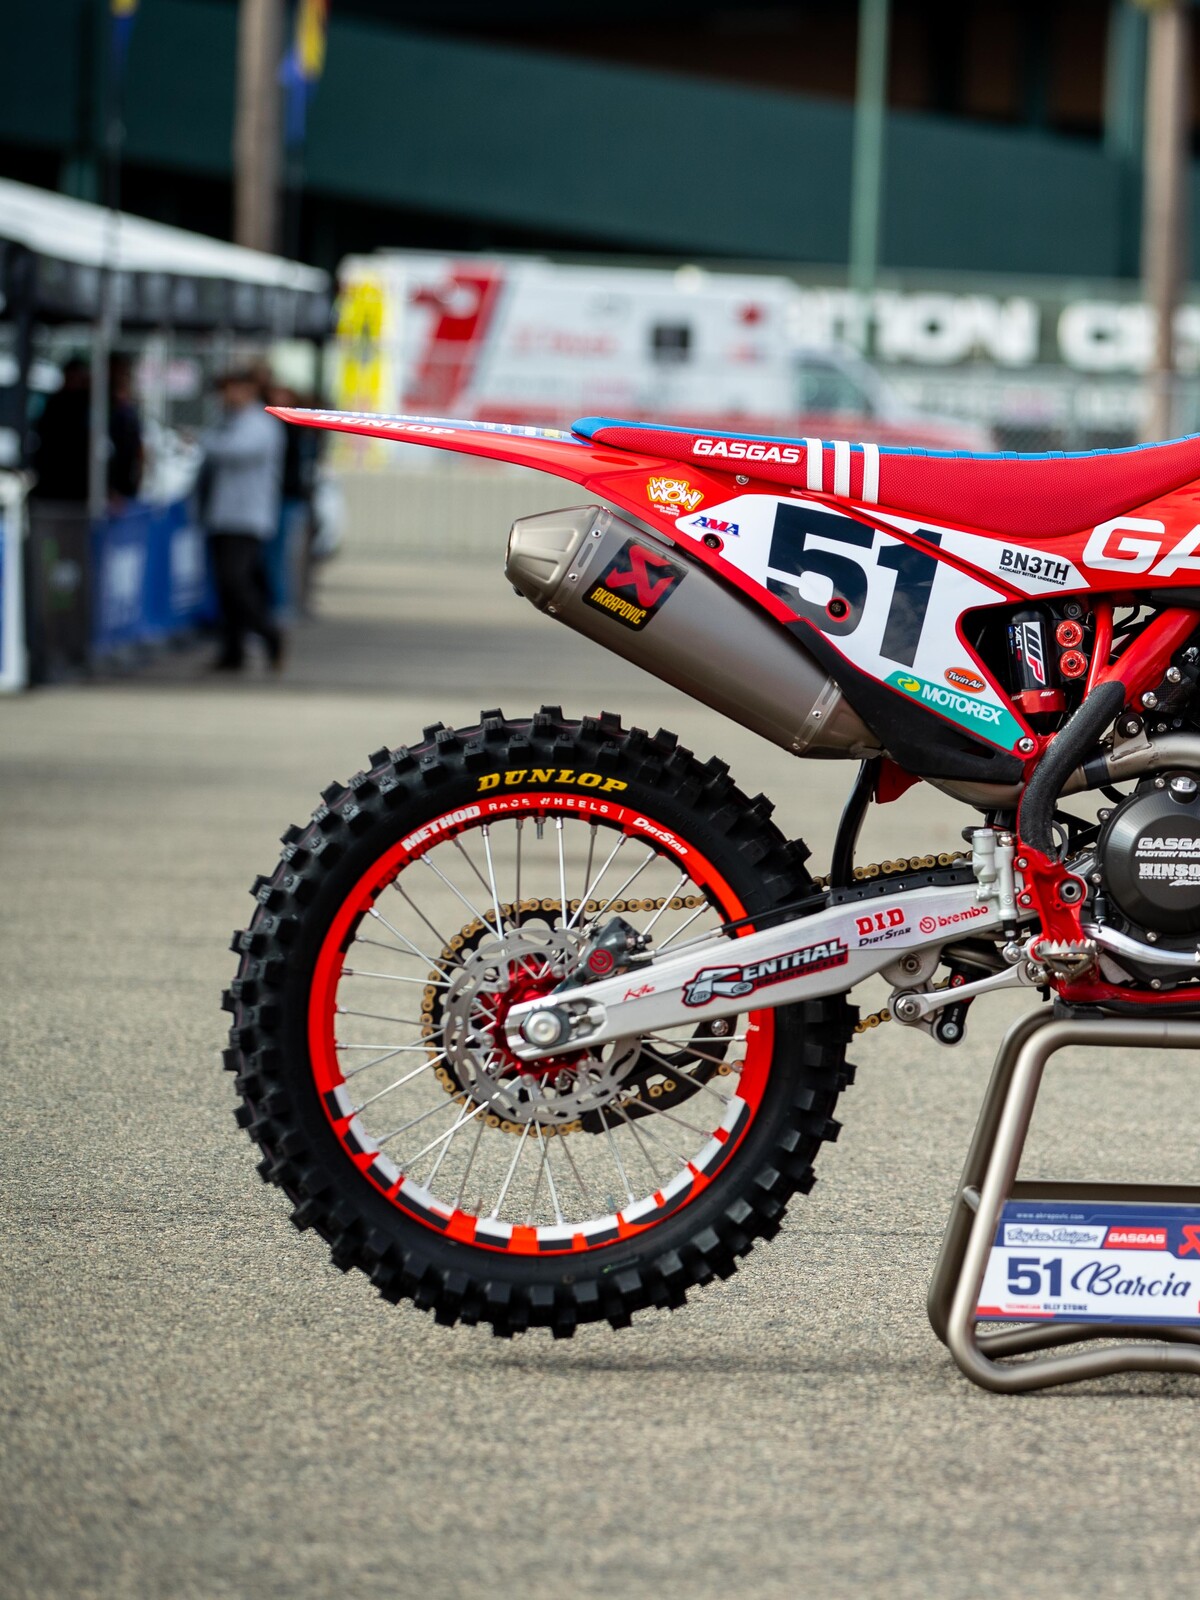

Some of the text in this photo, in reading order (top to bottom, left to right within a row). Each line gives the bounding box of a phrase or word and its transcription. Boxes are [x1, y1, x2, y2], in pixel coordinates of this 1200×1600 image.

[313, 414, 456, 434] DUNLOP
[692, 439, 801, 464] GASGAS
[648, 486, 703, 510] WOW!
[649, 478, 688, 493] WOW
[689, 516, 740, 537] AMA
[1000, 548, 1071, 581] BN3TH
[766, 502, 943, 668] 51
[1014, 625, 1023, 651] XACT
[1024, 624, 1045, 685] WP
[948, 671, 984, 689] Twin Air
[921, 684, 1003, 725] MOTOREX
[477, 768, 628, 793] DUNLOP
[401, 805, 482, 852] METHOD
[488, 798, 531, 812] RACE
[540, 797, 609, 814] WHEELS
[1135, 850, 1179, 858] FACTORY
[937, 906, 989, 927] brembo
[683, 941, 846, 1004] RENTHAL
[756, 956, 845, 988] CHAINWHEELS
[1016, 1212, 1085, 1220] www.akrapovic.com
[1108, 1232, 1166, 1245] GASGAS
[1007, 1257, 1063, 1297] 51
[1070, 1261, 1193, 1297] Barcia
